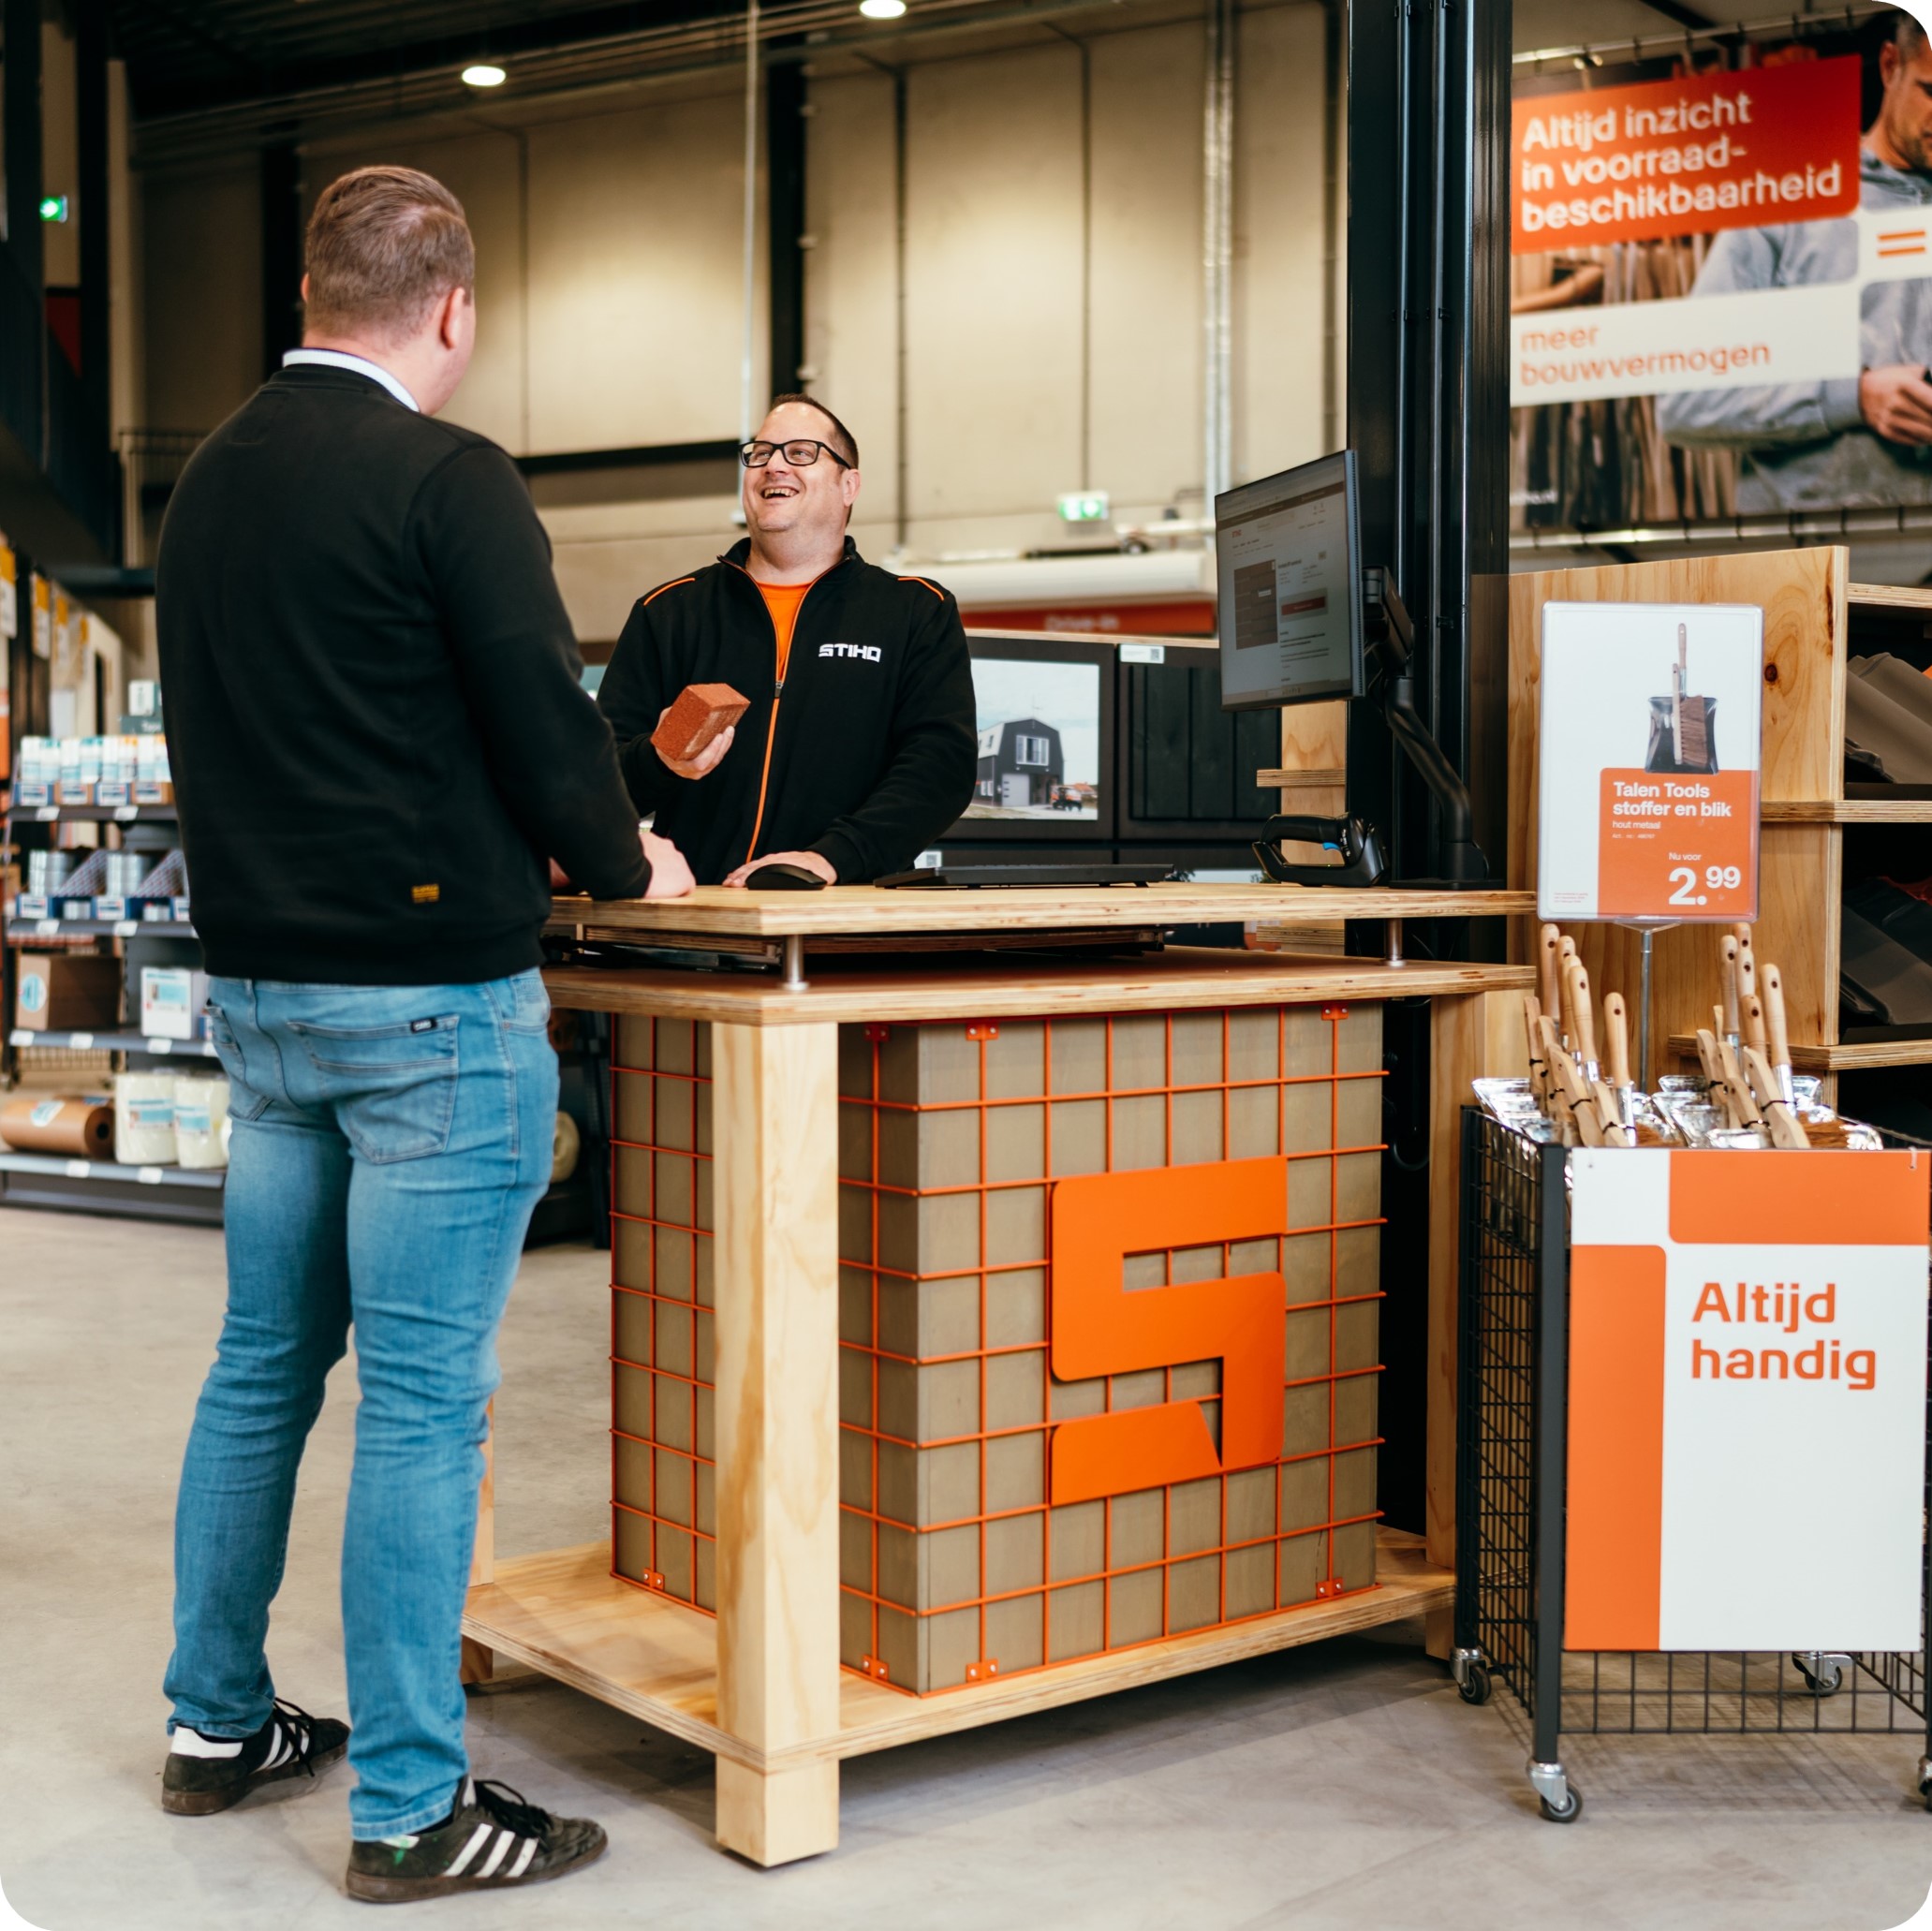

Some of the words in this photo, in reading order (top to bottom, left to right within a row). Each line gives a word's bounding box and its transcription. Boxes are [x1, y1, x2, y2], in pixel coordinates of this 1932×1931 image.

[1522, 107, 1617, 153] Altijd
[1625, 91, 1752, 140] inzicht
[1522, 159, 1555, 193] in
[1561, 134, 1748, 187] voorraad-
[1521, 160, 1843, 233] beschikbaarheid
[1521, 325, 1599, 352] meer
[1521, 342, 1771, 387] bouwvermogen
[818, 642, 882, 663] STIHO
[1613, 781, 1660, 798] Talen
[1663, 782, 1711, 799] Tools
[1612, 820, 1631, 830] hout
[1632, 821, 1661, 831] metaal
[1613, 801, 1672, 817] stoffer
[1674, 803, 1697, 817] en
[1701, 802, 1733, 818] blik
[1668, 852, 1682, 862] Nu
[1683, 853, 1702, 862] voor
[1692, 1282, 1836, 1334] Altijd
[1691, 1338, 1877, 1391] handig
